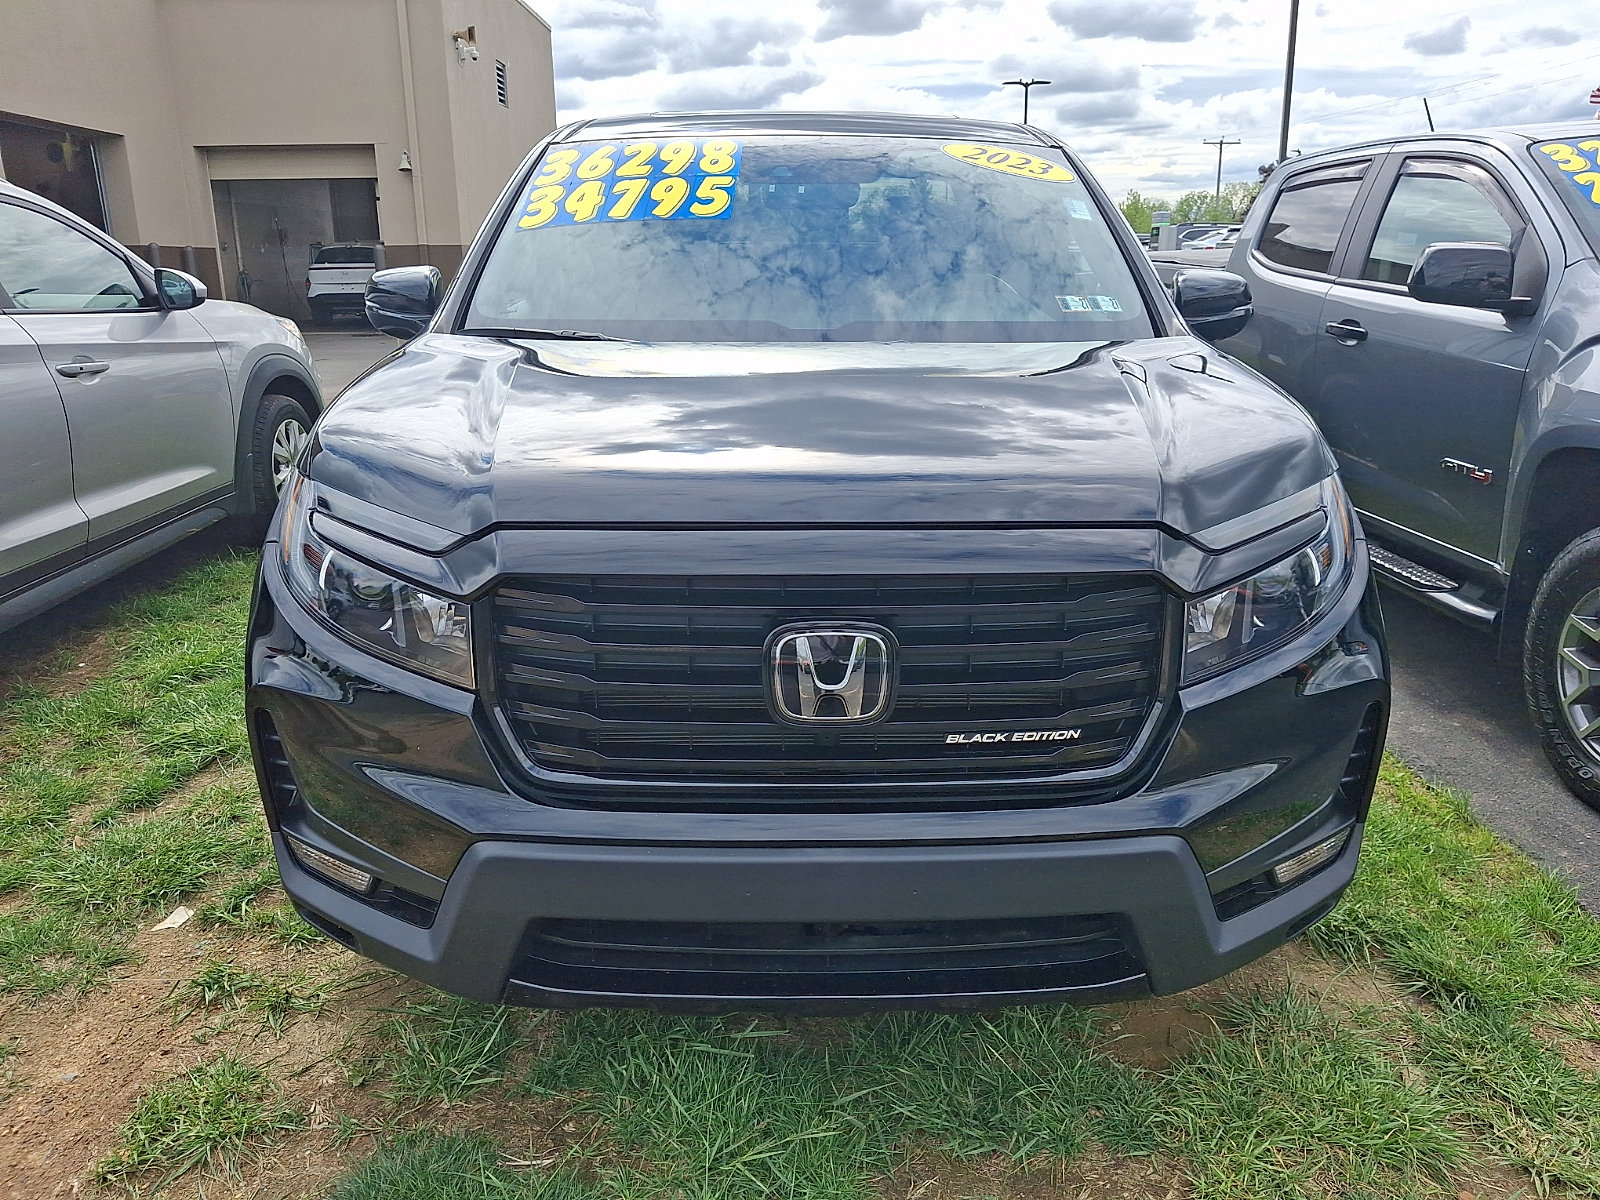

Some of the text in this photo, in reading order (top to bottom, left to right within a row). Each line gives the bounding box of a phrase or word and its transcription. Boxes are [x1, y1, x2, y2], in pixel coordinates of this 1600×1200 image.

[534, 140, 739, 186] 36298
[961, 147, 1055, 175] 2023
[518, 175, 736, 229] 34795
[945, 729, 1082, 745] BLACK EDITION
